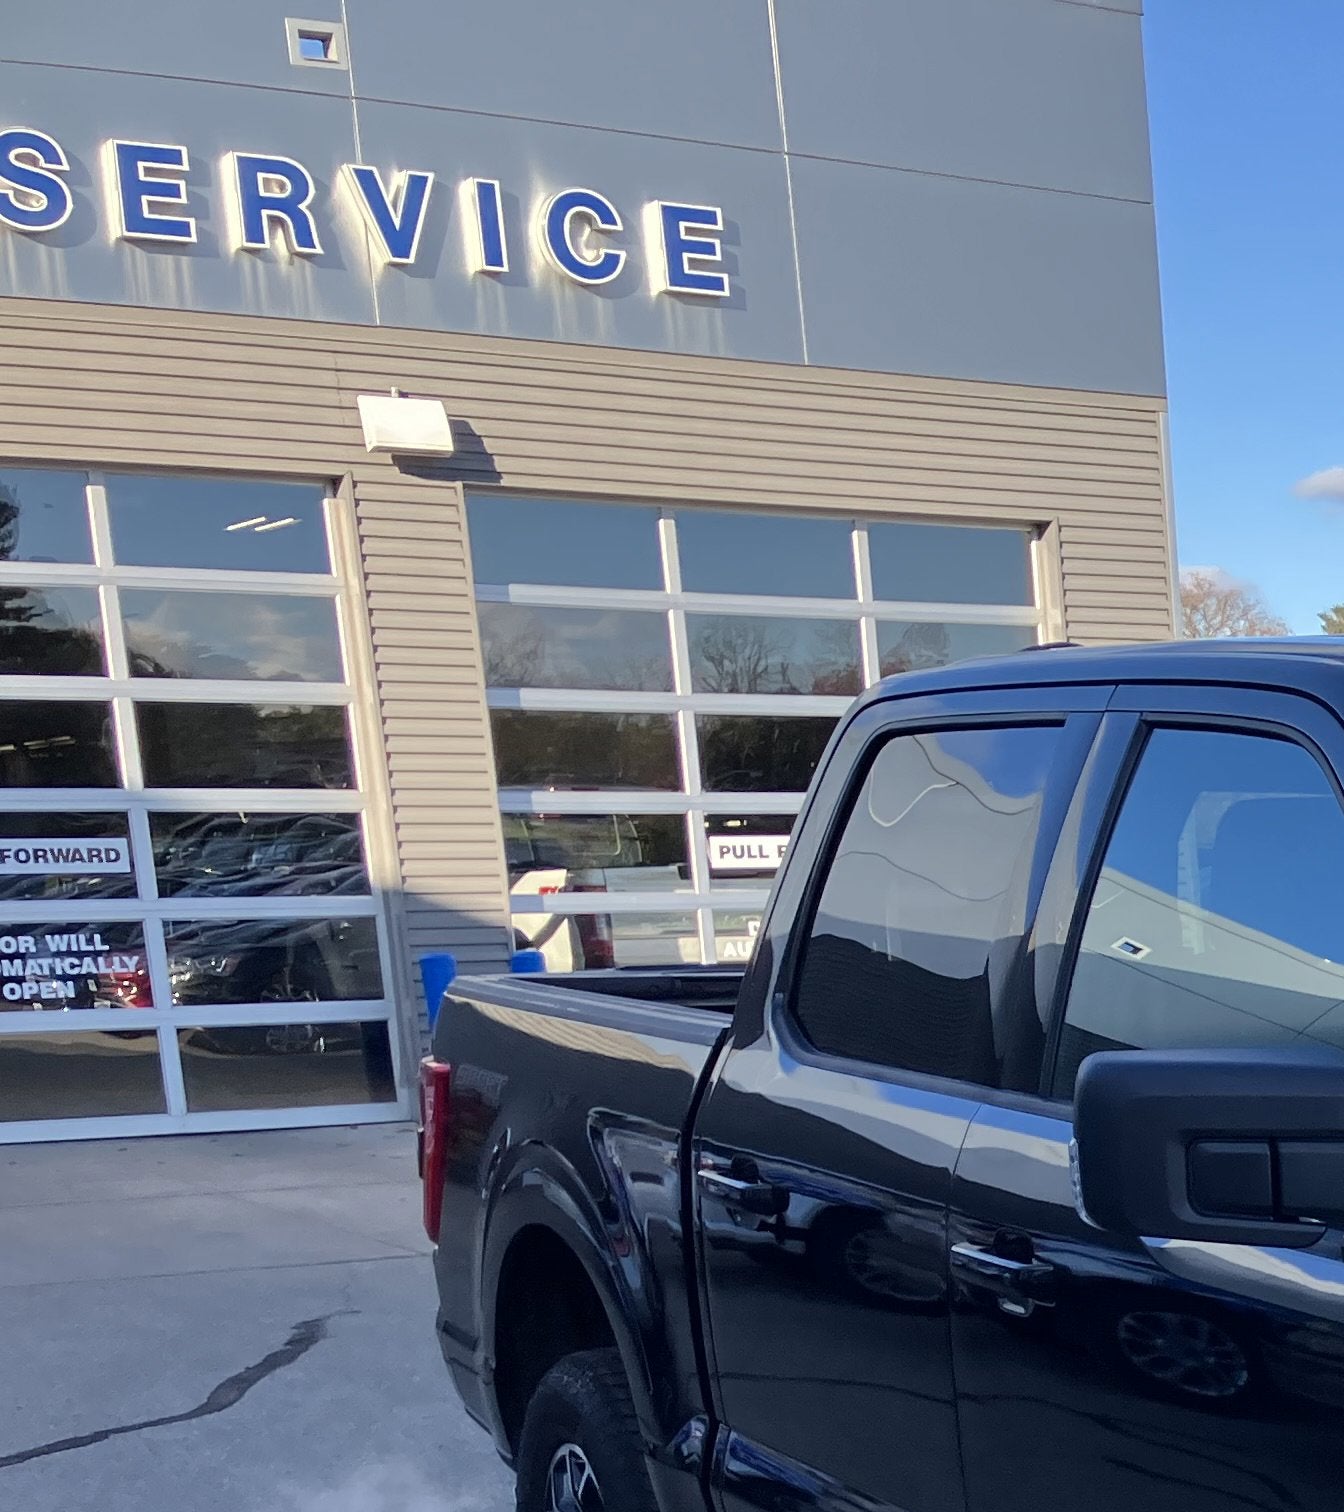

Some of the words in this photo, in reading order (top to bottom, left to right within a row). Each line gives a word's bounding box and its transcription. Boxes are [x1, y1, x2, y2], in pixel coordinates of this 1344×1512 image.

[0, 126, 732, 297] SERVICE
[0, 847, 121, 864] FORWARD
[718, 844, 770, 859] PULL
[44, 933, 110, 952] WILL
[0, 955, 140, 977] MATICALLY
[2, 980, 76, 1001] OPEN
